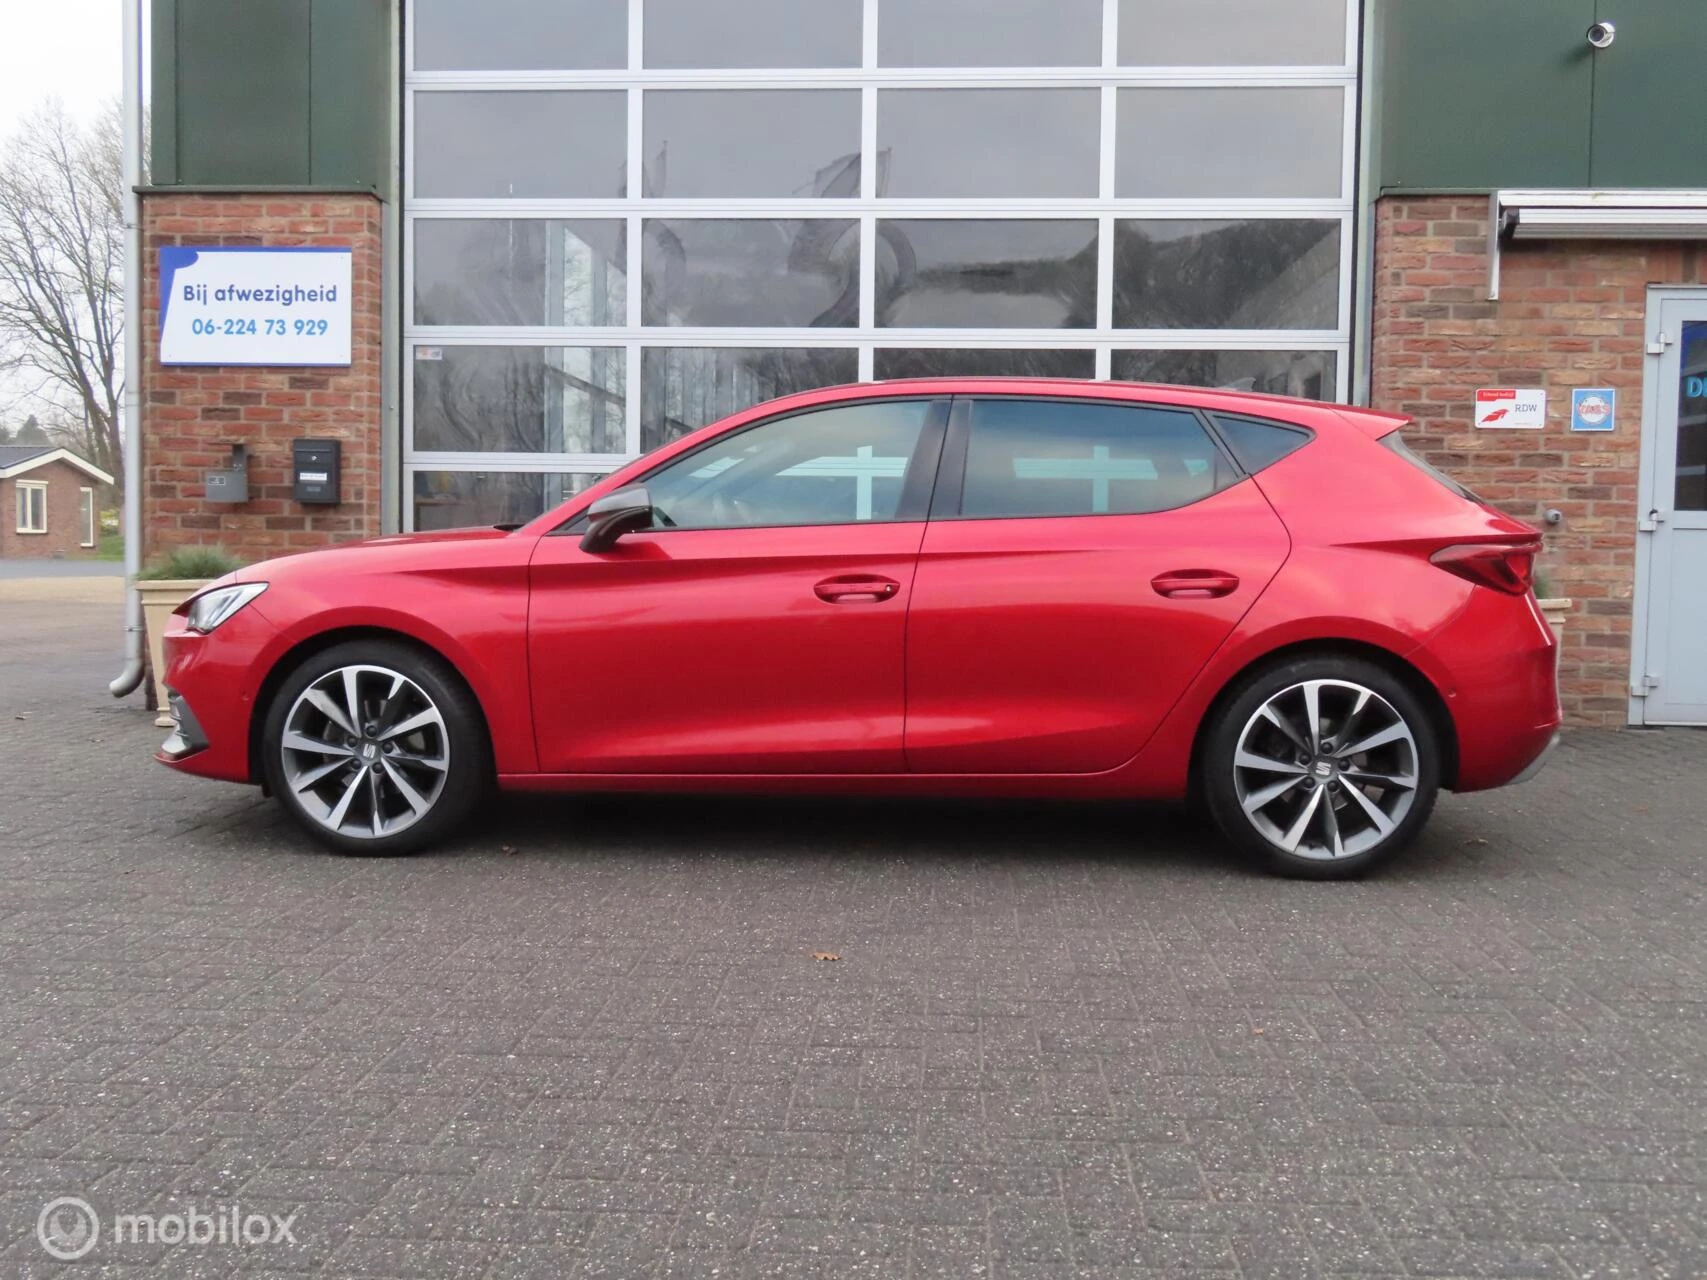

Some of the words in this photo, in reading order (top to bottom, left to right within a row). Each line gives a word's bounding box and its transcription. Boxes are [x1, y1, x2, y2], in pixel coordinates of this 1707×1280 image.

[183, 284, 207, 306] Bij
[214, 284, 337, 307] afwezigheid
[191, 318, 257, 336] 06-224
[264, 318, 287, 336] 73
[294, 318, 328, 336] 929
[1687, 375, 1707, 398] D
[1515, 403, 1538, 413] RDW
